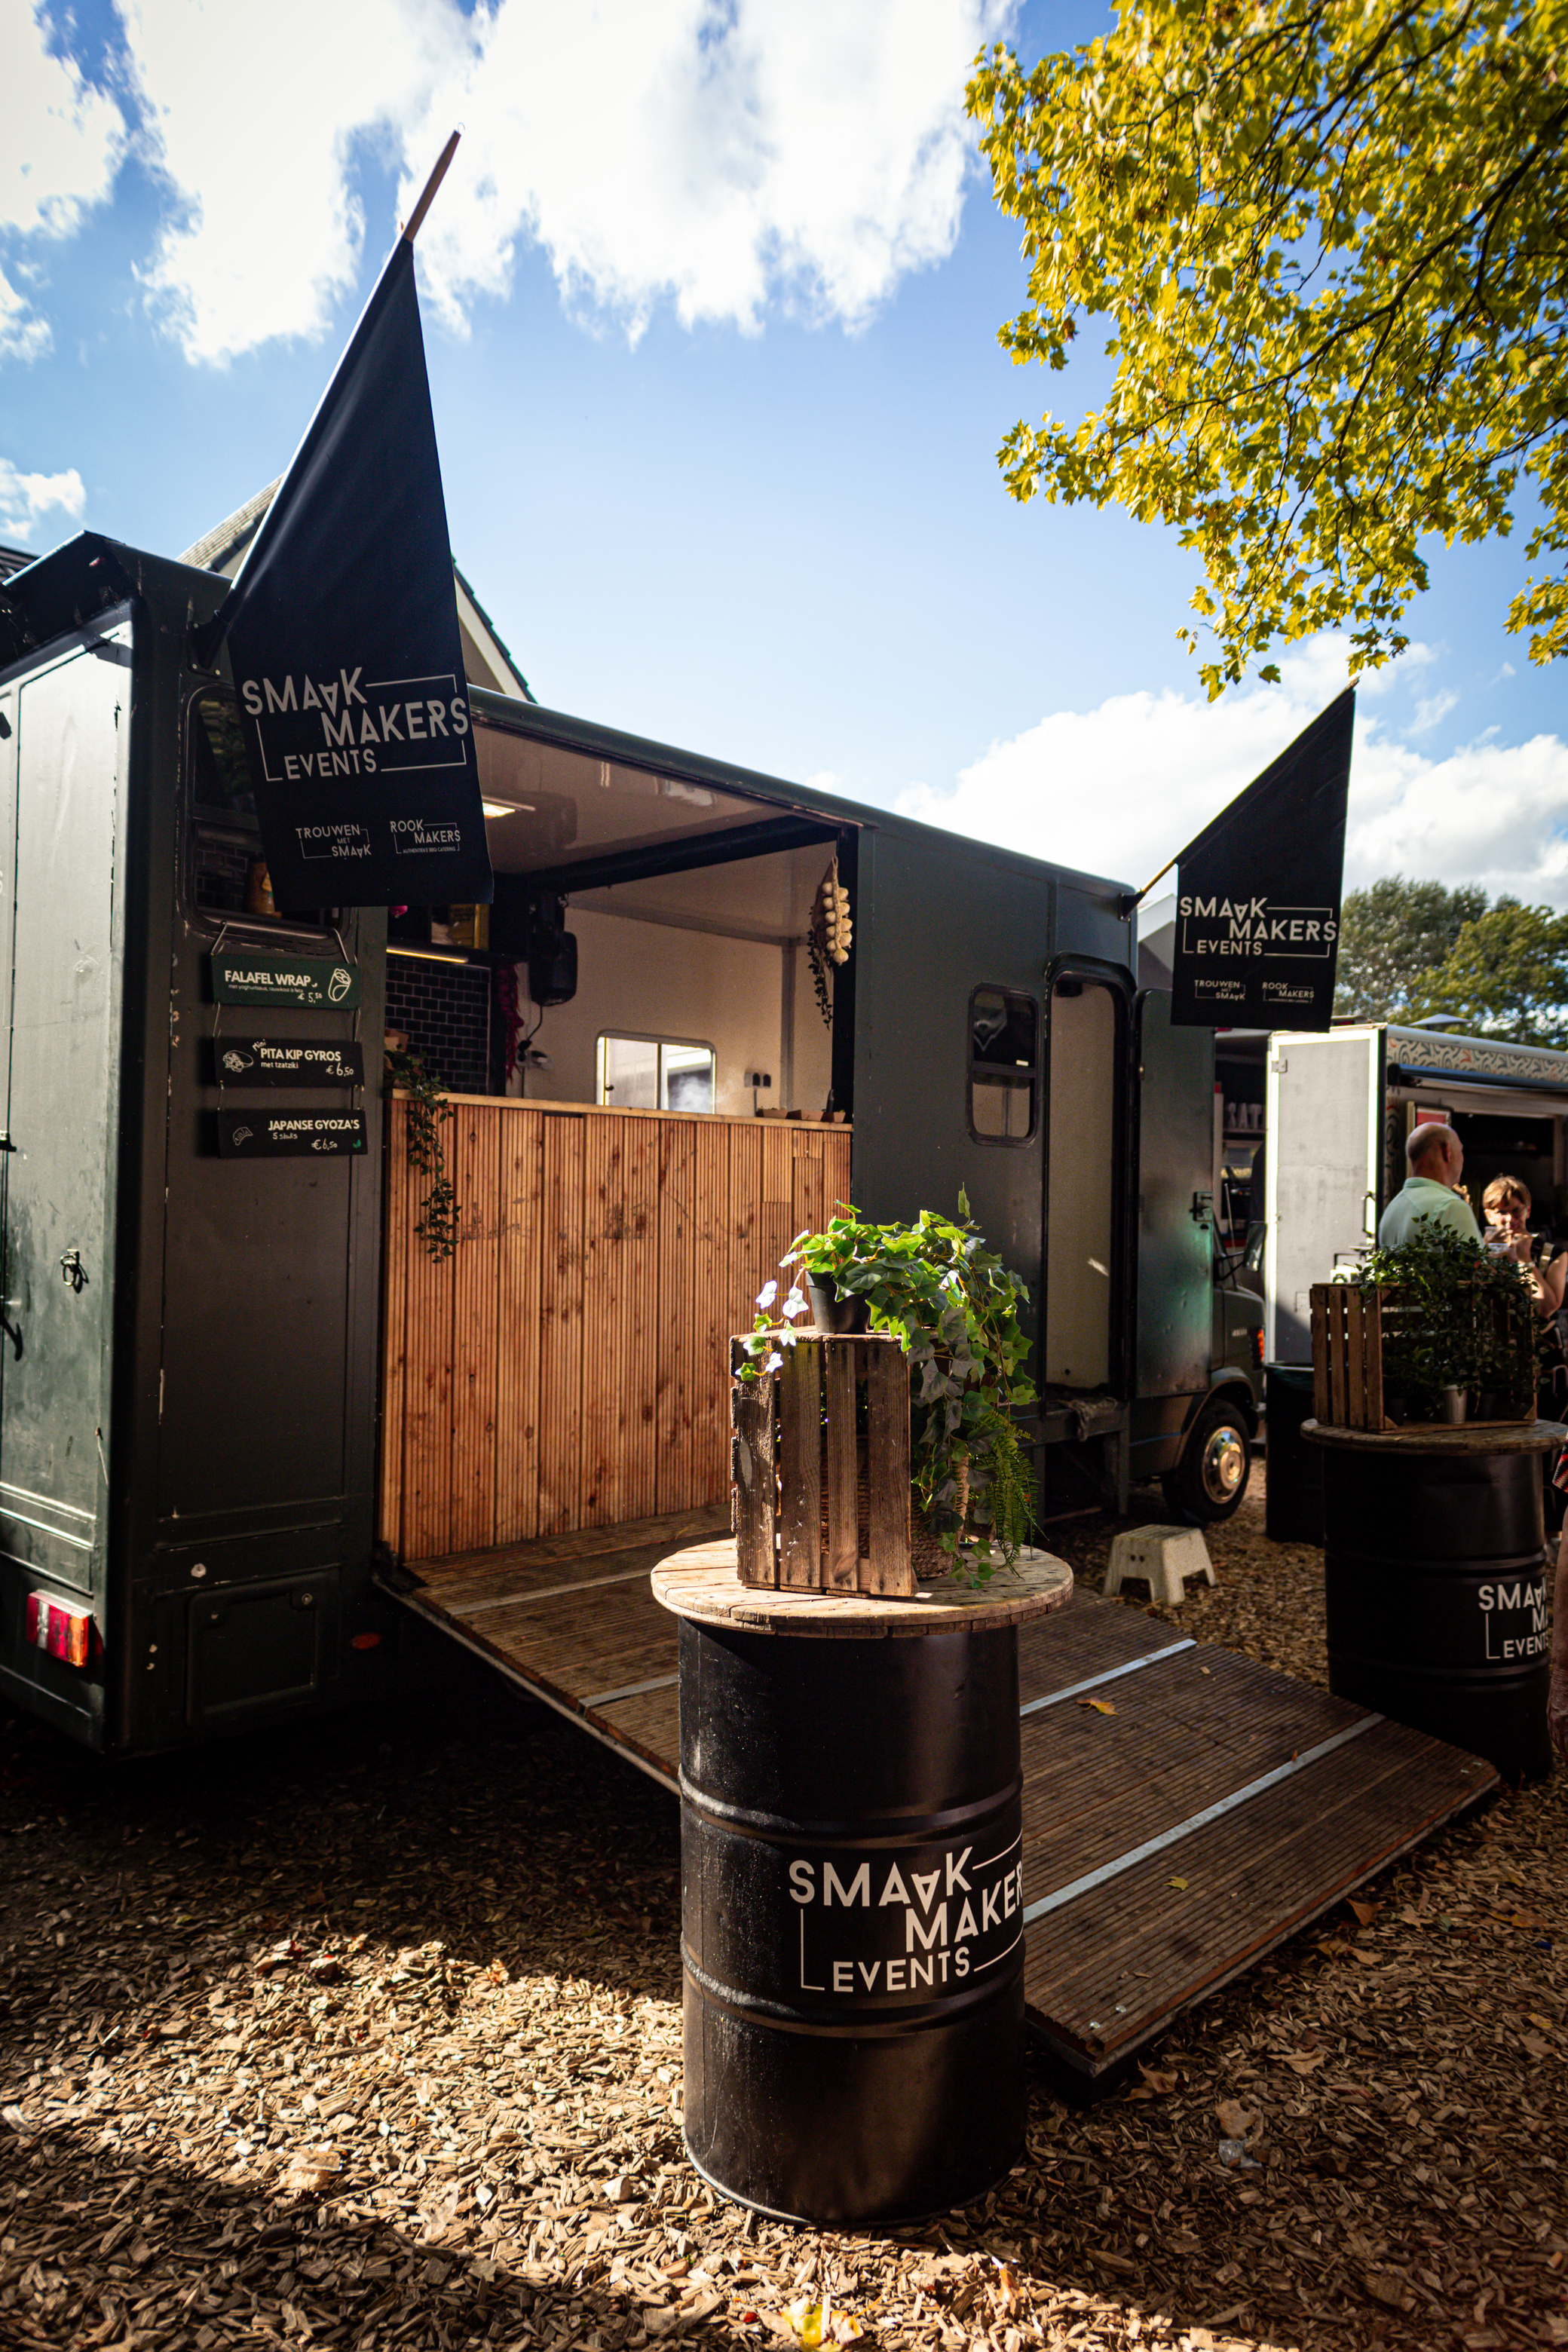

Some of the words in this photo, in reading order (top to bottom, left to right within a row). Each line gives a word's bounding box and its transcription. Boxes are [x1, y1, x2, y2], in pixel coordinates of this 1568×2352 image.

[321, 697, 468, 747] MAKERS
[284, 749, 377, 779] EVENTS
[296, 824, 360, 839] TROUWEN
[390, 819, 424, 833] ROOK
[414, 830, 461, 844] MAKERS
[1229, 918, 1337, 942] MAKERS
[1196, 939, 1263, 955] EVENTS
[225, 970, 274, 985] FALAFEL
[274, 973, 311, 987] WRAP
[1194, 980, 1240, 988] TROUWEN
[1262, 982, 1288, 990] ROOK
[1279, 990, 1315, 998] MAKERS
[260, 1048, 285, 1060] PITA
[286, 1049, 303, 1060] KIP
[305, 1049, 341, 1061] GYROS
[268, 1119, 314, 1131] JAPANSE
[314, 1119, 360, 1130] GYOZA'S
[272, 1132, 278, 1140] 5
[833, 1946, 969, 1992] EVENTS
